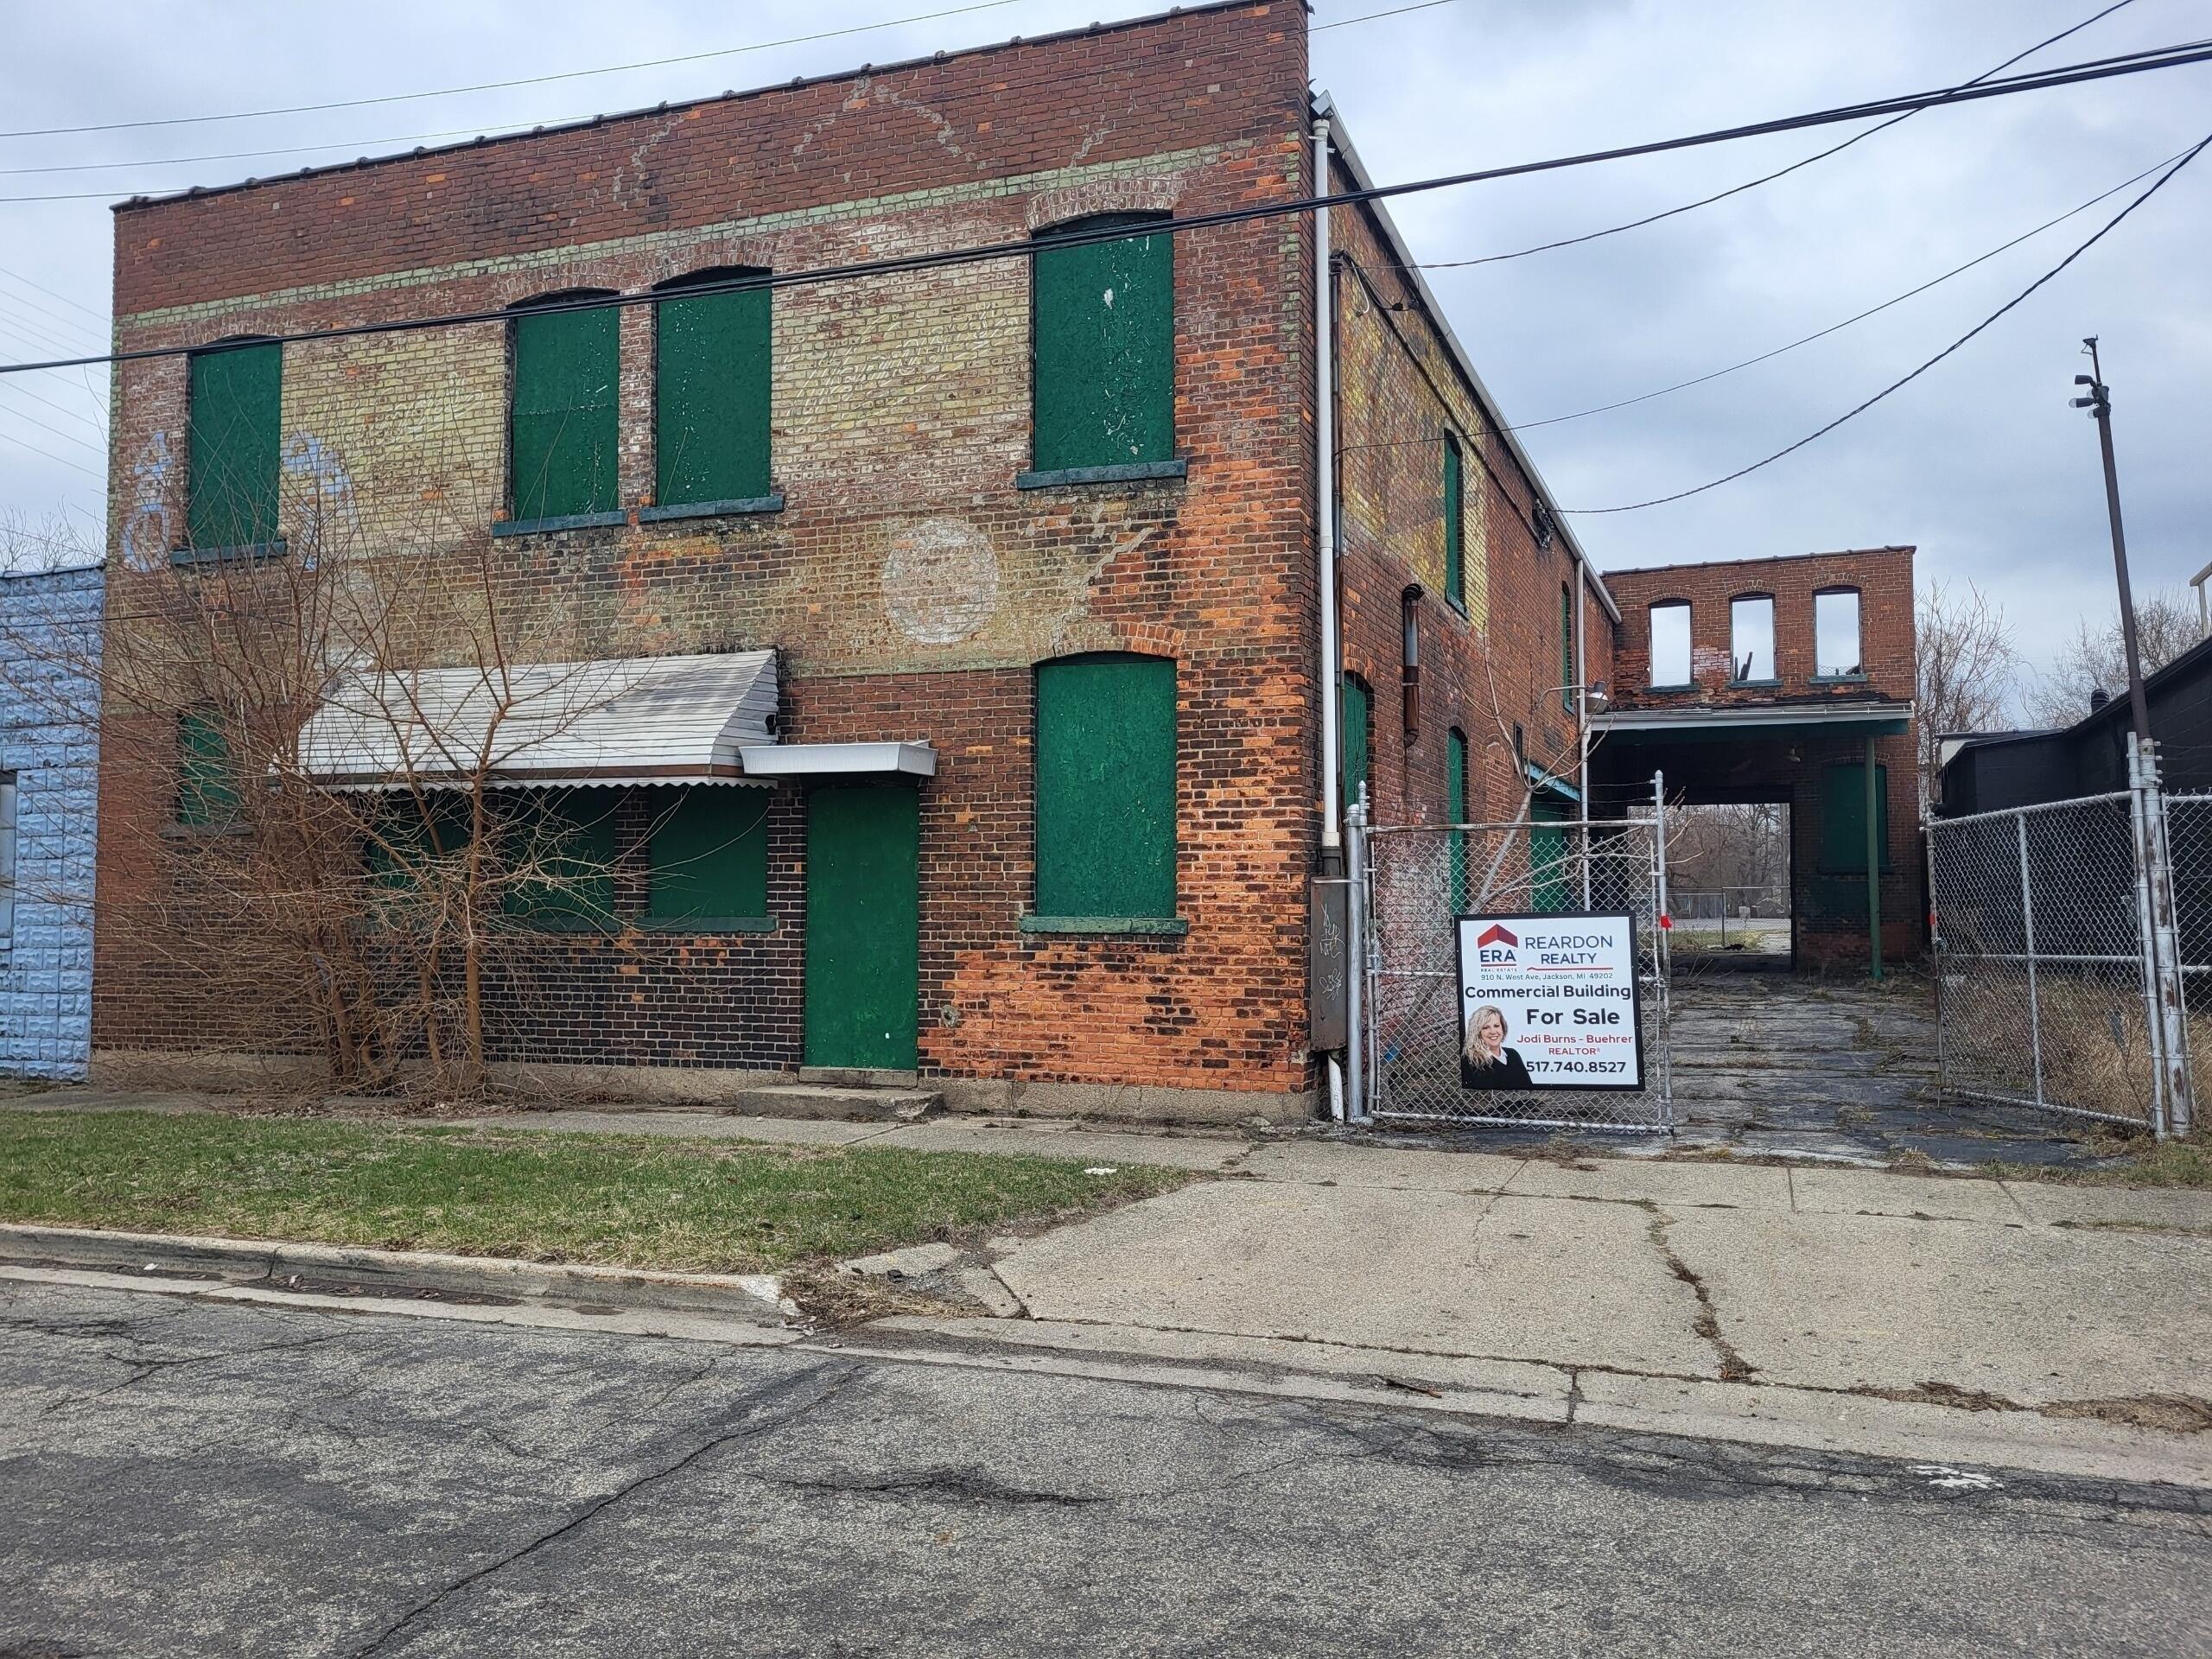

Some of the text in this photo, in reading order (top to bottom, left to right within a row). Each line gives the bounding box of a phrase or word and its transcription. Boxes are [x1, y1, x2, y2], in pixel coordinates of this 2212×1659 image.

[1525, 936, 1612, 950] REARDON
[1480, 950, 1516, 963] ERA
[1541, 953, 1597, 964] REALTY
[1465, 984, 1631, 1000] Commercial Building
[1527, 1008, 1620, 1025] For Sale
[1517, 1035, 1541, 1044] Jodi
[1545, 1035, 1576, 1044] Burns
[1586, 1035, 1633, 1044] Buehrer
[1527, 1061, 1626, 1073] 517.740.8527
